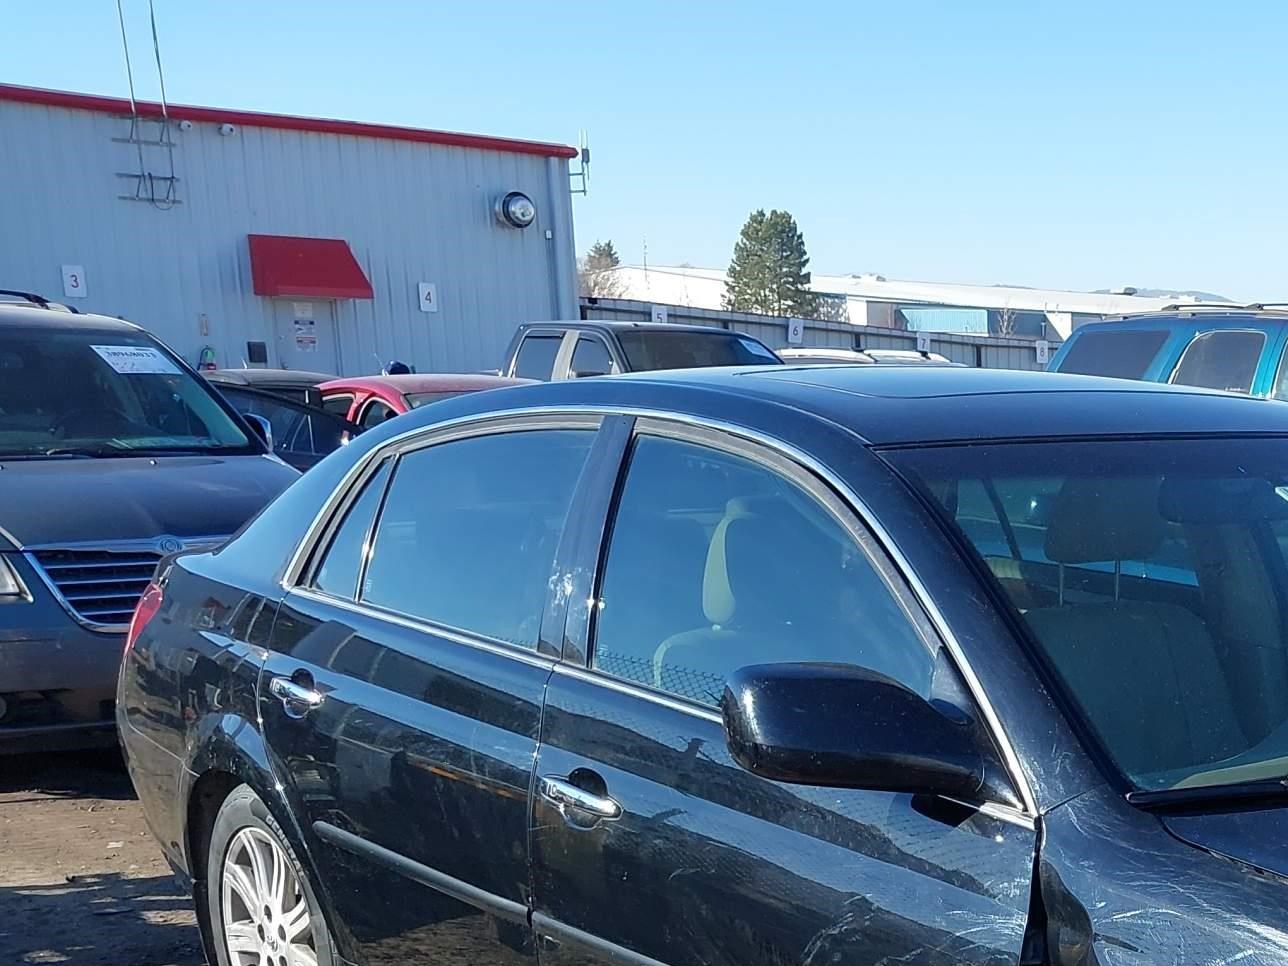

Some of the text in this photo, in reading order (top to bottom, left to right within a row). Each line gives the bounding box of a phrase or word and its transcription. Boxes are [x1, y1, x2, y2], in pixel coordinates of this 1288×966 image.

[69, 274, 80, 289] 3
[424, 290, 434, 305] 4
[792, 326, 800, 337] 6
